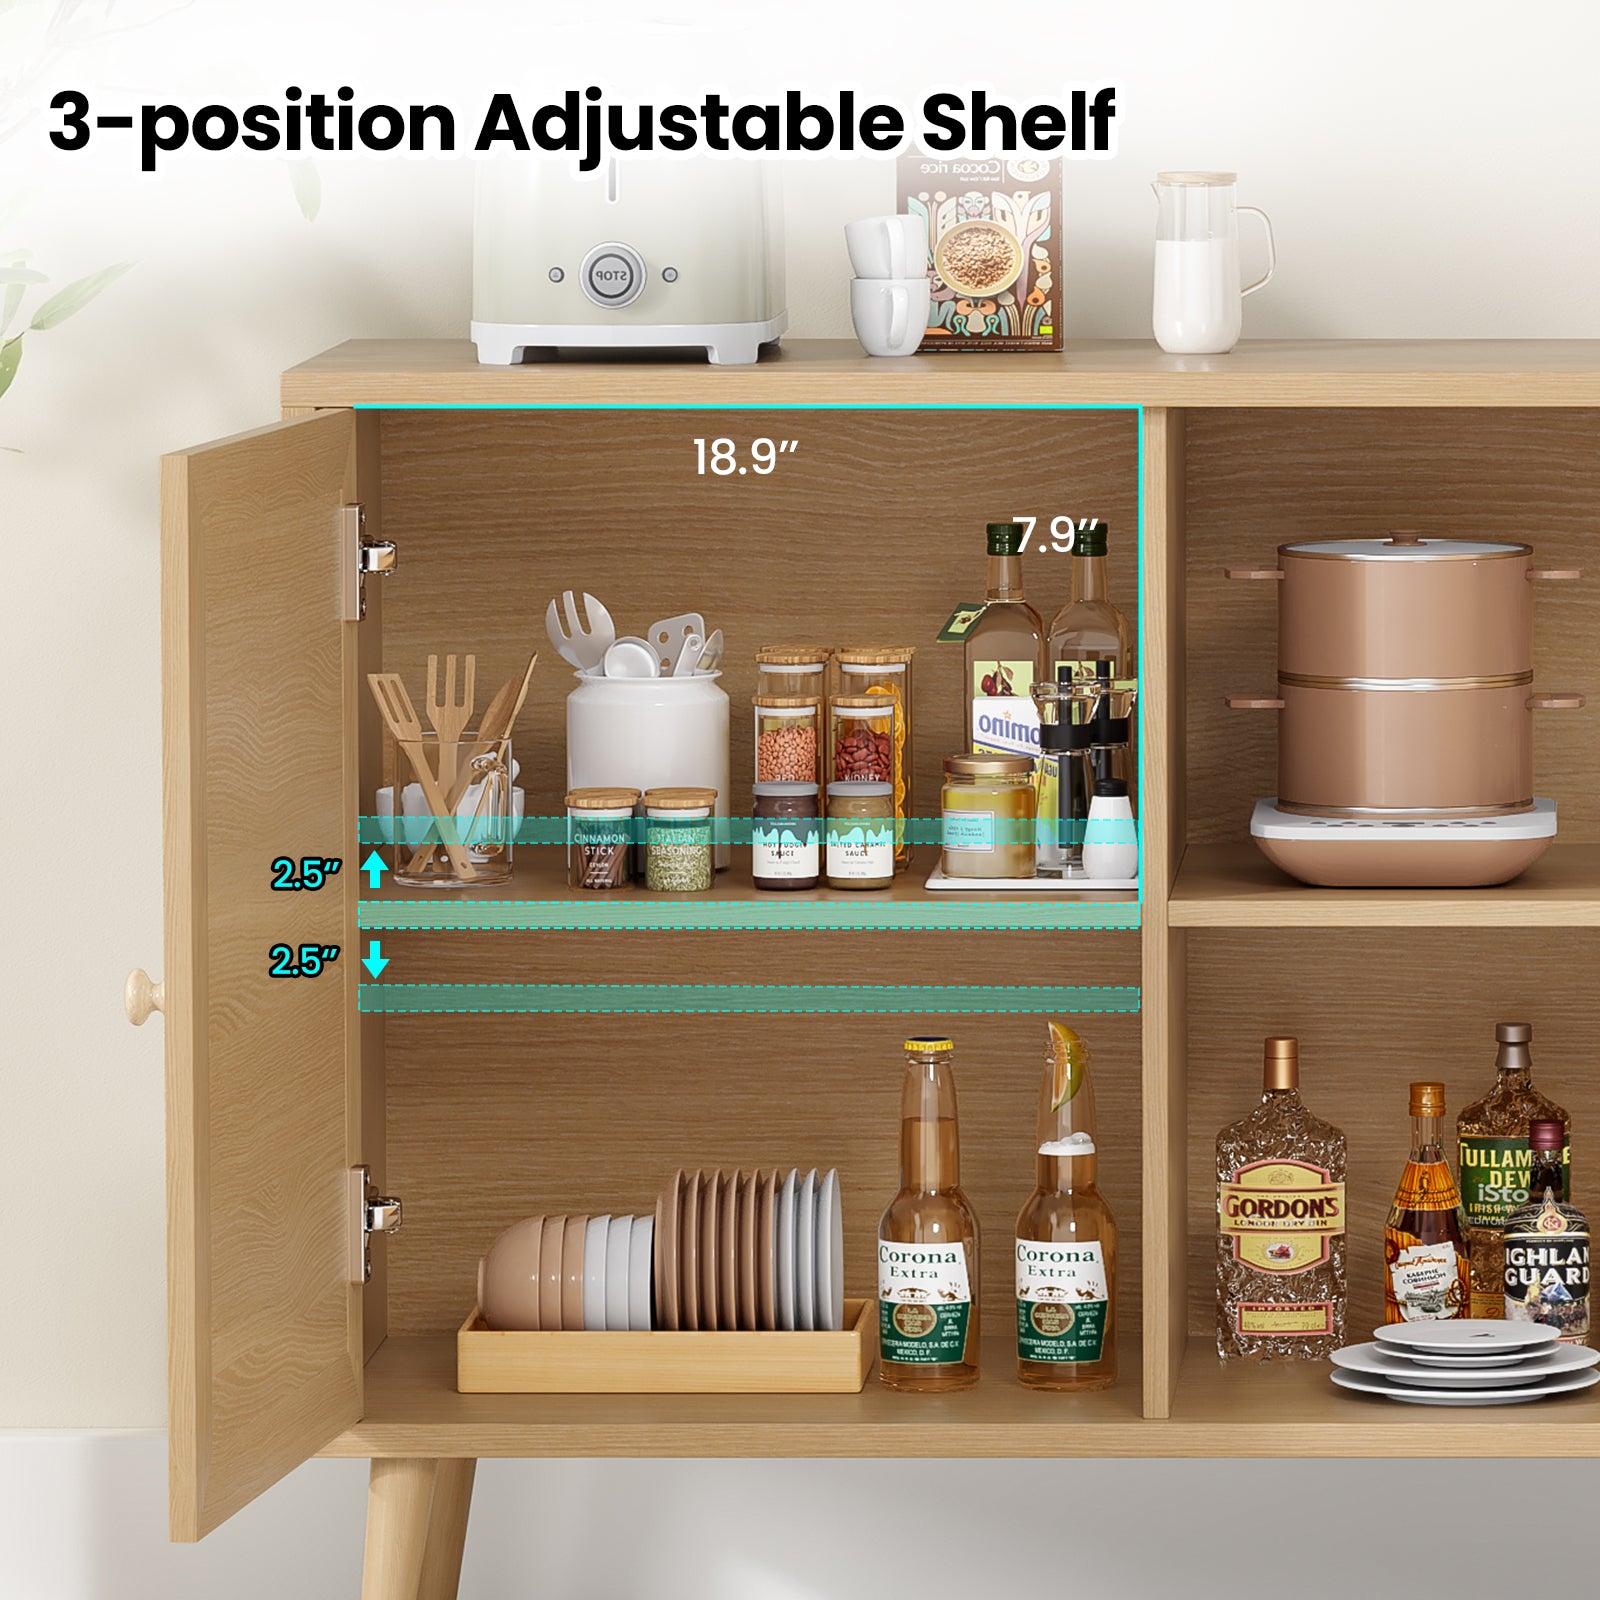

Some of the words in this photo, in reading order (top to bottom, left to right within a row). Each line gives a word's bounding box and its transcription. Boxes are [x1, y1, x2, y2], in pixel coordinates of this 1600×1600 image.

[844, 773, 881, 782] KIDNEY
[574, 833, 625, 844] CINNAMON
[584, 846, 615, 856] STICK
[1460, 1142, 1571, 1167] TULLAME
[1223, 1194, 1340, 1219] GORDON'S
[879, 1245, 957, 1264] Corona
[1017, 1244, 1095, 1263] Corona
[890, 1266, 939, 1279] Extra
[1028, 1265, 1077, 1278] Extra
[1504, 1267, 1590, 1287] GUARD
